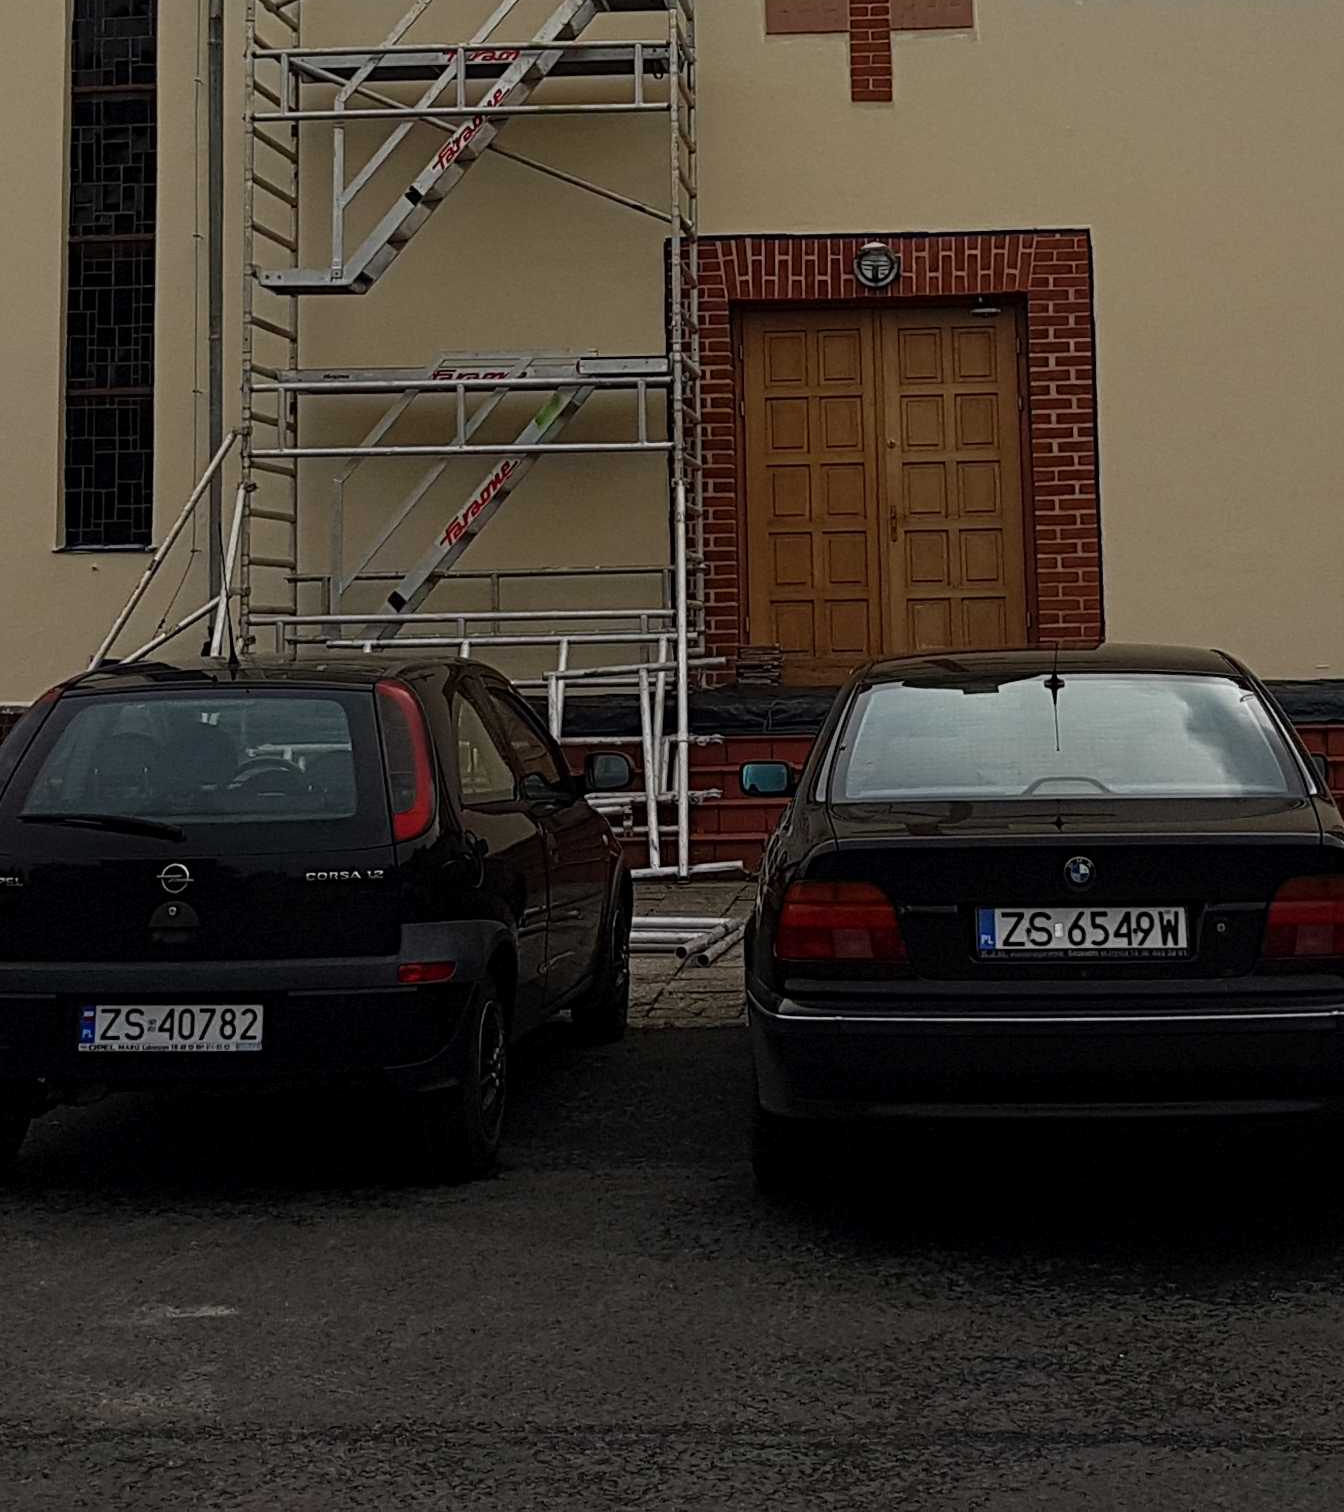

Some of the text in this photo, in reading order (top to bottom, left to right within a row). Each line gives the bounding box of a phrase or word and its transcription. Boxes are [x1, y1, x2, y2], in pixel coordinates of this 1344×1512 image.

[305, 871, 362, 881] CORSA
[1001, 911, 1179, 946] ZS 6549W
[100, 1008, 258, 1041] ZS 40782
